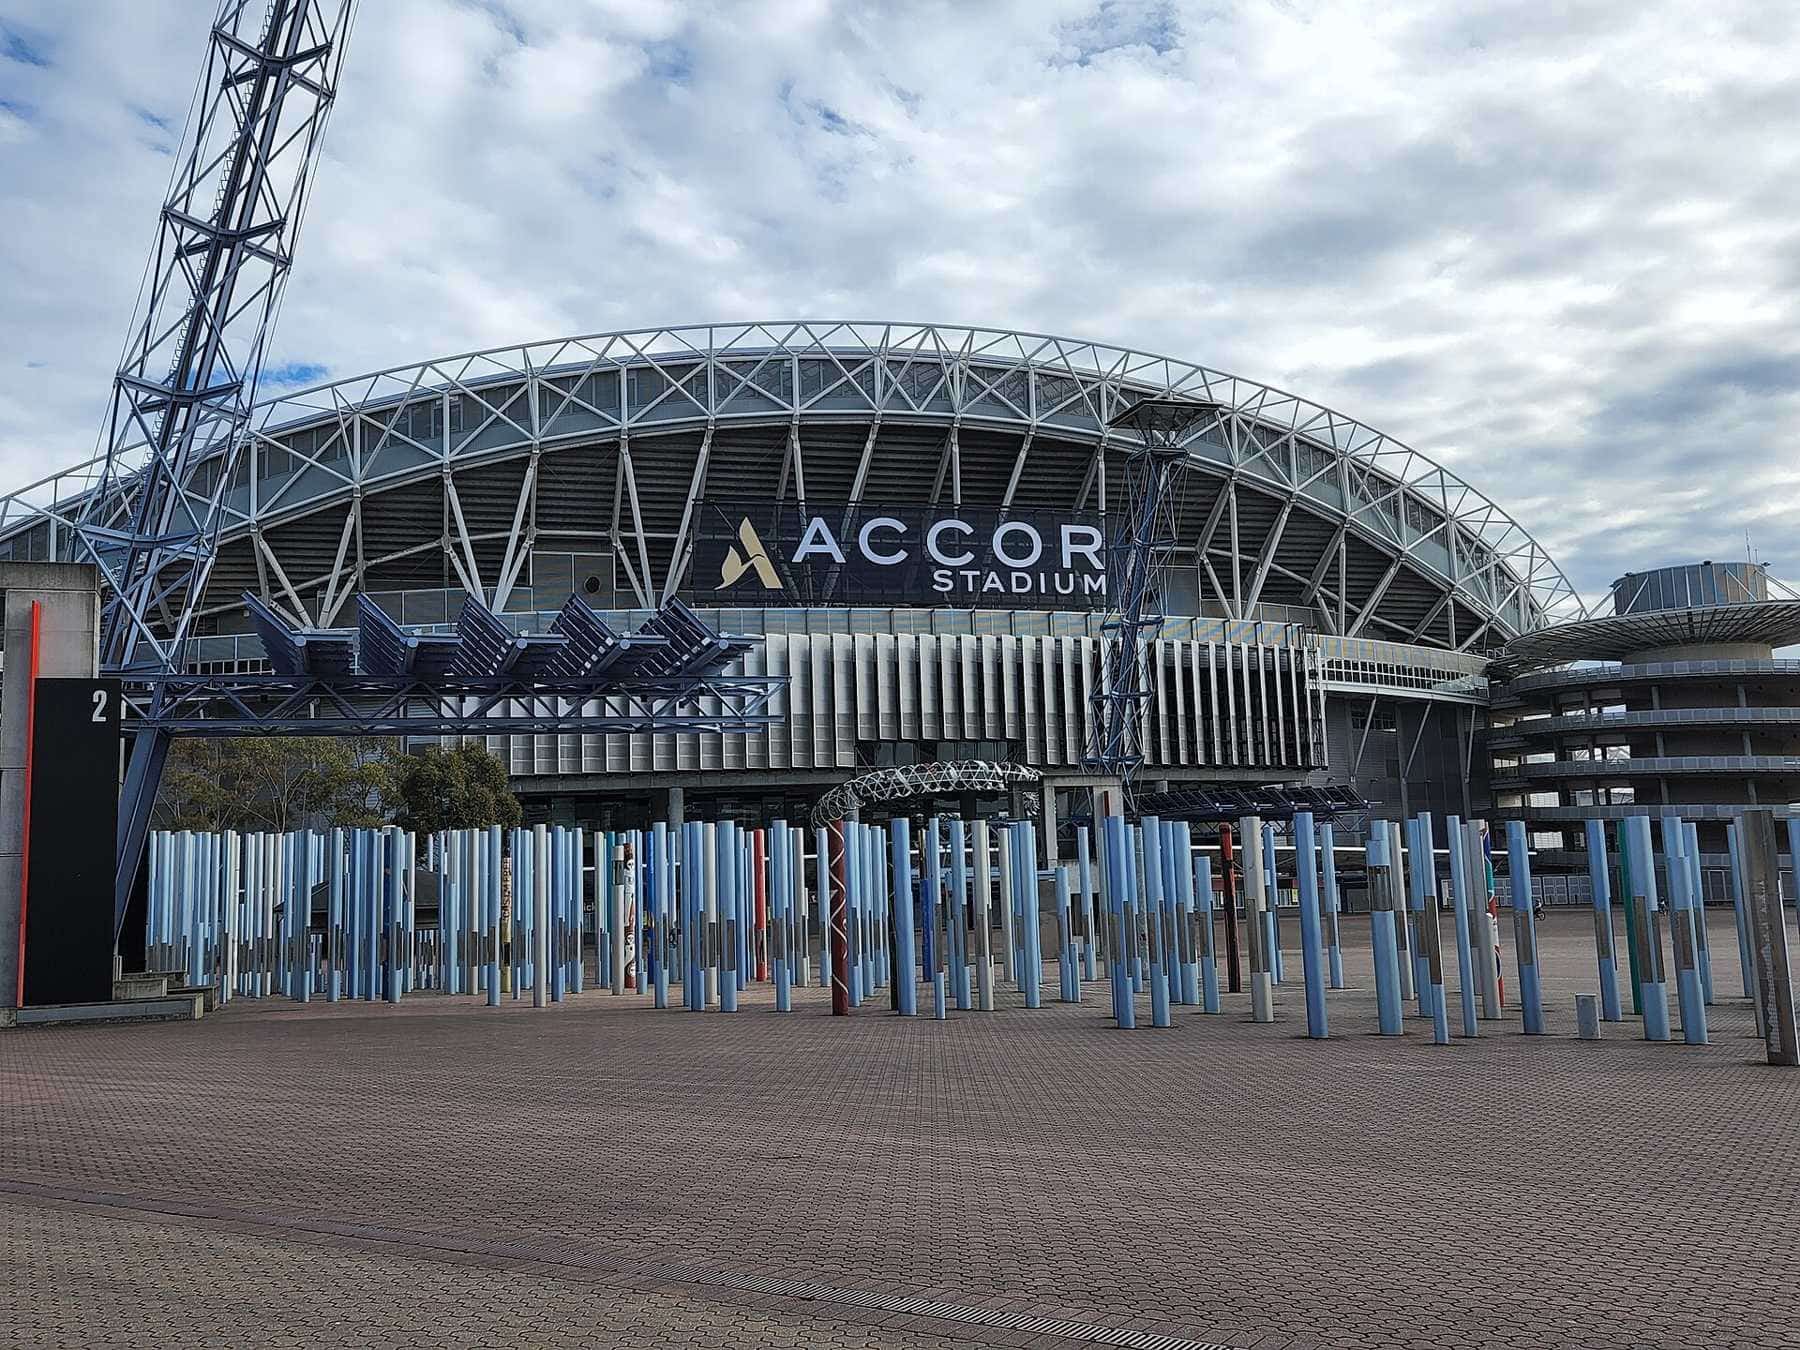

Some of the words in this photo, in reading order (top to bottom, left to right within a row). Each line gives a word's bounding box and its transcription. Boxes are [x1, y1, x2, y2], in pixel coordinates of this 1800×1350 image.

[791, 516, 1106, 569] ACCOR
[932, 569, 1107, 595] STADIUM
[92, 690, 107, 722] 2
